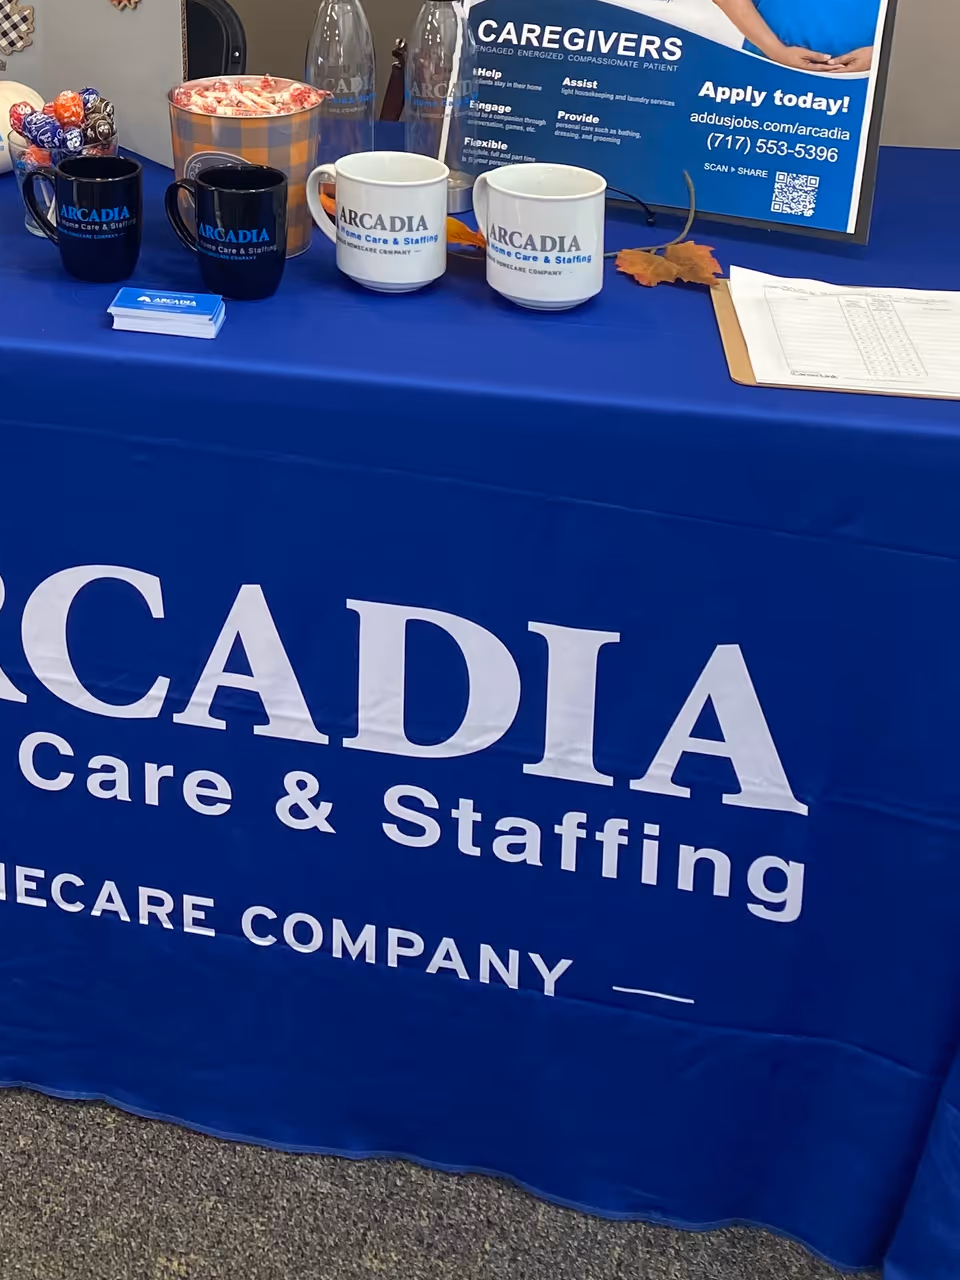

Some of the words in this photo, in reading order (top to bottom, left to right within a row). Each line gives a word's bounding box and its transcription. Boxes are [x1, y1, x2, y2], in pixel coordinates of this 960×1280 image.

[478, 19, 683, 61] CAREGIVERS
[475, 45, 514, 54] ENGAGED
[518, 49, 564, 60] ENERGIZED
[568, 54, 639, 68] COMPASSIONATE
[643, 63, 678, 71] PATIENT
[563, 77, 598, 88] Assist
[698, 81, 767, 107] Apply
[774, 89, 850, 115] today!
[558, 111, 600, 123] Provide
[690, 112, 850, 140] addusjobs.com/arcadia
[707, 132, 750, 154] (717)
[756, 139, 838, 162] 553-5396
[704, 163, 728, 173] SCAN
[738, 167, 768, 178] SHARE
[61, 204, 130, 222] ARCADIA
[340, 206, 428, 232] ARCADIA
[199, 223, 269, 243] ARCADIA
[341, 225, 361, 240] Home
[365, 234, 388, 244] Care
[404, 235, 439, 245] Staffing
[490, 223, 581, 252] ARCADIA
[491, 242, 511, 257] Home
[515, 252, 538, 261] Care
[555, 255, 592, 264] Staffing
[153, 297, 196, 306] ARCADIA
[17, 730, 234, 816] Care
[275, 770, 337, 834] &
[381, 783, 806, 924] Staffing
[240, 904, 574, 998] COMPANY
